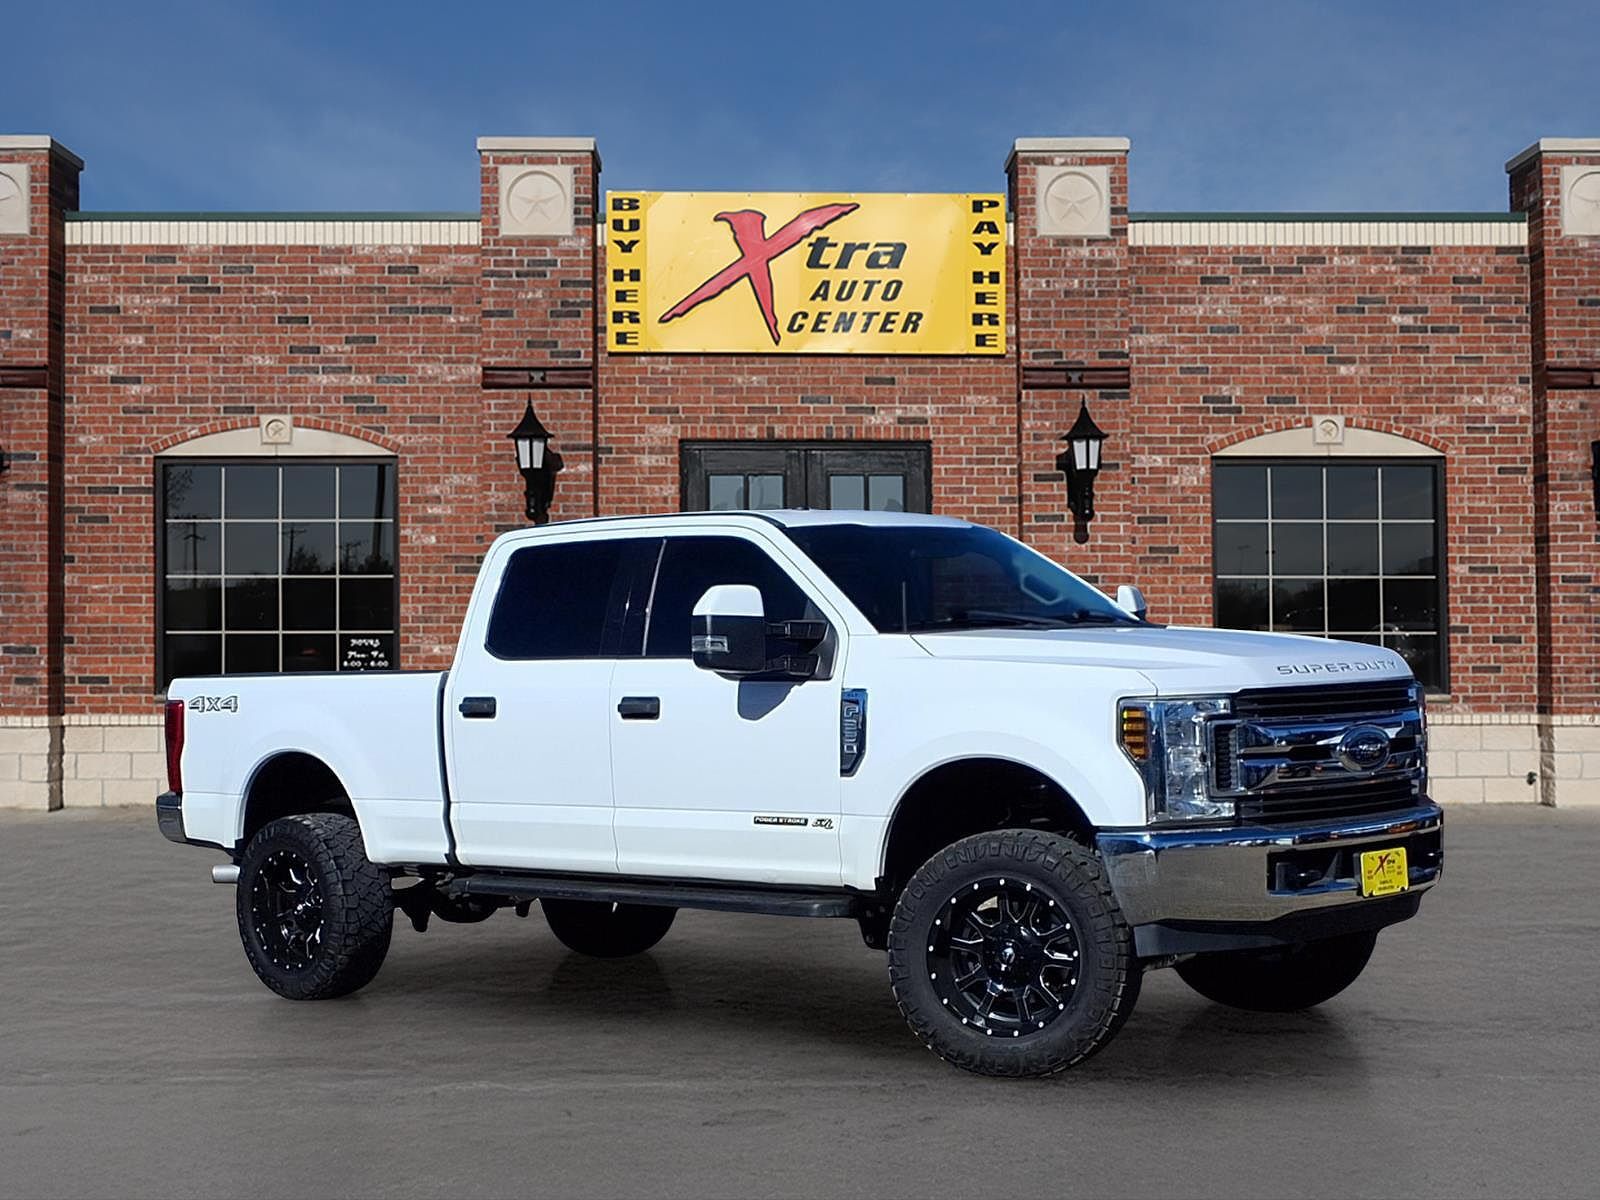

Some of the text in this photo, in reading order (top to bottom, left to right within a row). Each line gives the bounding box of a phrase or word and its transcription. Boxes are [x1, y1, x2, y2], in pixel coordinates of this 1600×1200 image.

[612, 198, 640, 345] BUY HERE
[972, 200, 1000, 347] PAY HERE
[809, 279, 904, 302] AUTO
[786, 311, 924, 334] CENTER
[1277, 659, 1396, 675] SUPER DUTY
